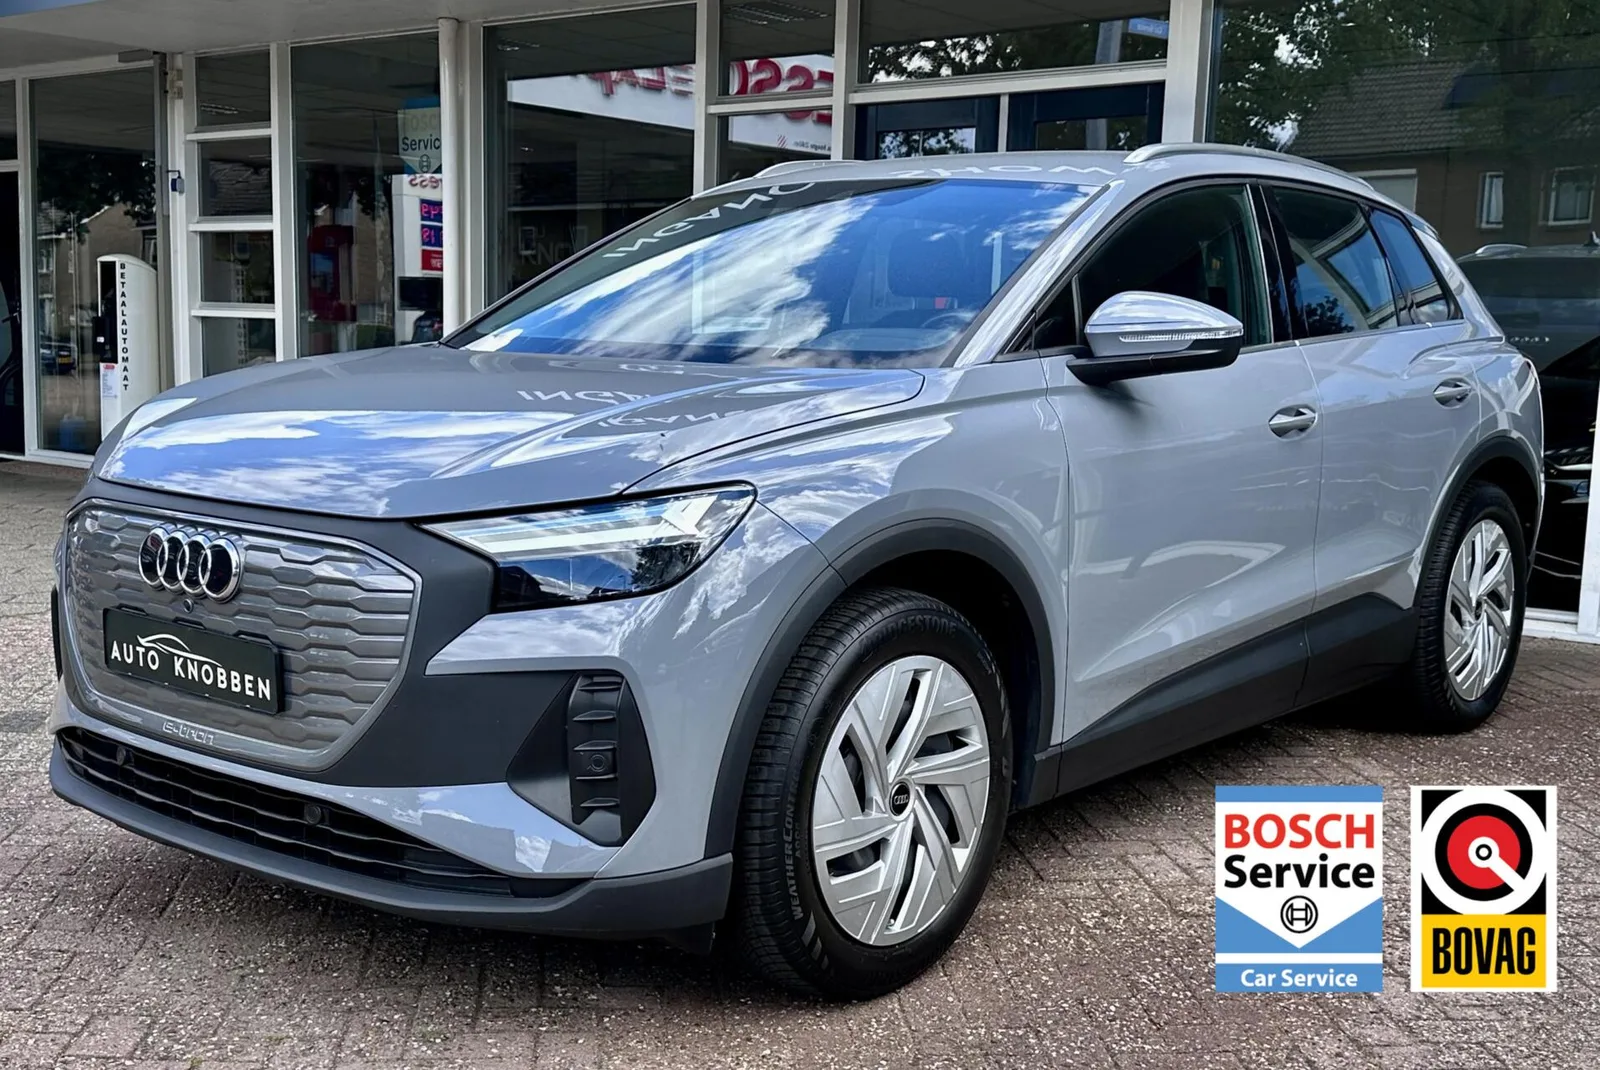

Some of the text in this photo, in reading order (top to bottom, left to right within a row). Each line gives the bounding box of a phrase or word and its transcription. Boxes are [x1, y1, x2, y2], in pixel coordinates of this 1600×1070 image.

[401, 133, 441, 152] Servic
[120, 263, 129, 391] BETAALAUTOMAAT
[110, 640, 272, 701] AUTO KNOBBEN
[162, 720, 215, 745] e-tron
